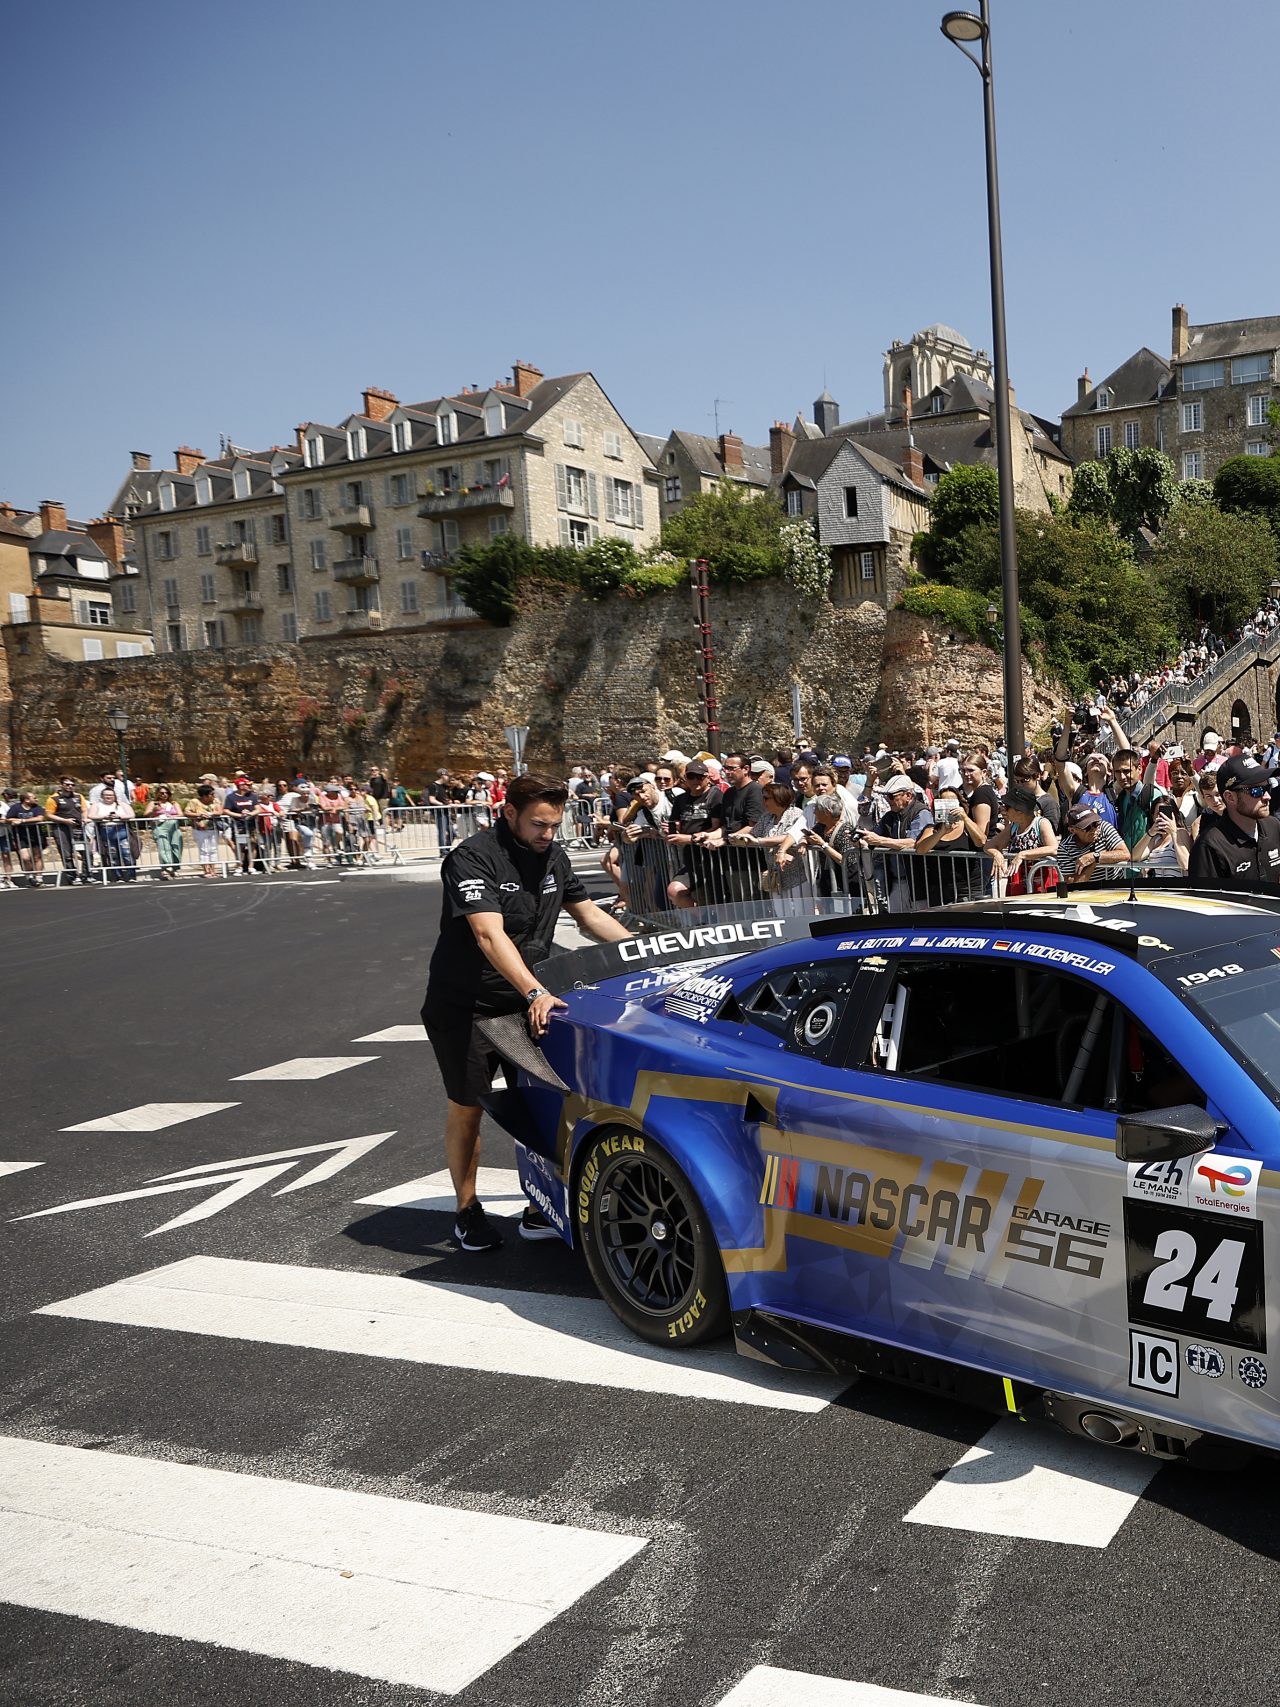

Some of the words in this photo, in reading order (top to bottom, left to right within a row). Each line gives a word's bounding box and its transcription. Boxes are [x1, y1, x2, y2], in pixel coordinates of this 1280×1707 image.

[618, 919, 786, 962] CHEVROLET
[860, 936, 908, 949] BUTTON
[935, 937, 990, 949] JOHNSON
[1009, 941, 1026, 953] M.
[1023, 943, 1116, 976] ROCKENFELLER
[1176, 963, 1245, 987] 1948
[1133, 1180, 1147, 1190] LE
[1147, 1182, 1180, 1196] MANS
[1195, 1196, 1250, 1213] TotalEnergies
[815, 1165, 992, 1253] NASCAR
[1011, 1205, 1111, 1239] GARAGE
[1004, 1222, 1109, 1280] 56
[1143, 1229, 1246, 1323] 24
[668, 1288, 707, 1339] EAGLE
[1137, 1341, 1173, 1385] IC
